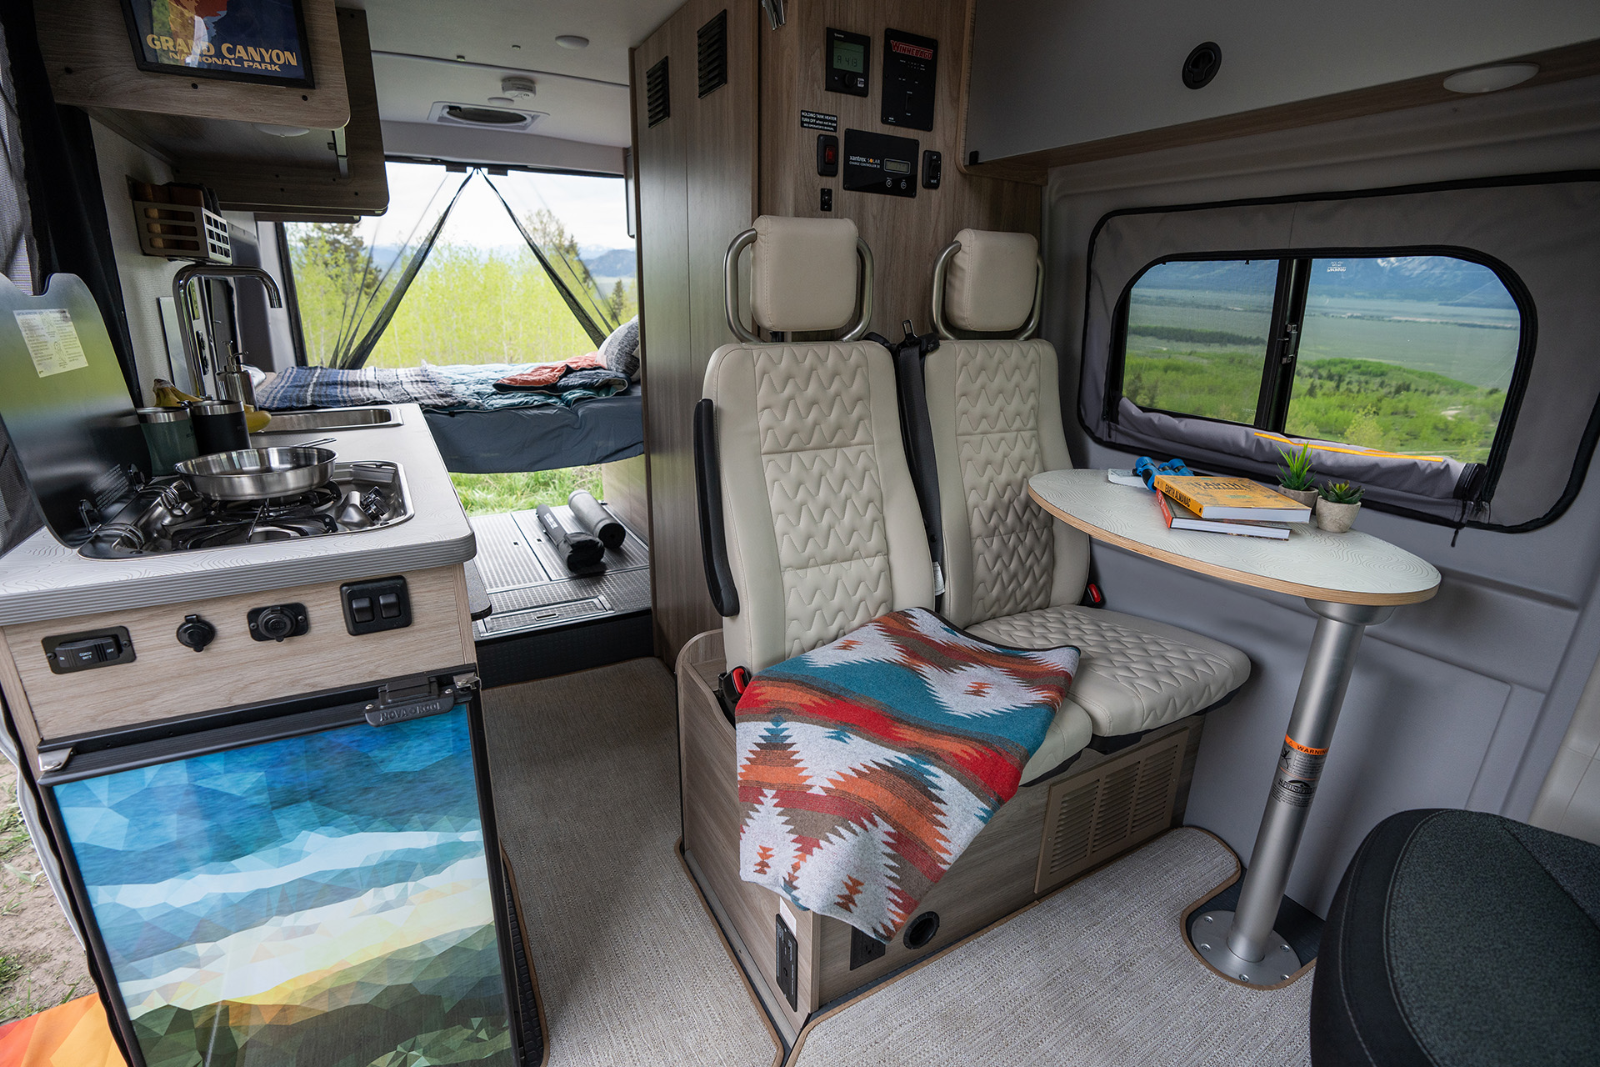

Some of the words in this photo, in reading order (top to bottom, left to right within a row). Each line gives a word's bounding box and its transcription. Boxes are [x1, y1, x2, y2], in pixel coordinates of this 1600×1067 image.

[146, 34, 215, 56] GRAND
[221, 43, 298, 66] CANYON
[890, 39, 934, 60] WINNEBAGO
[244, 61, 281, 72] PARK
[1165, 484, 1175, 498] EARTH
[1174, 490, 1191, 508] ALMANAC
[380, 708, 408, 721] NOVA
